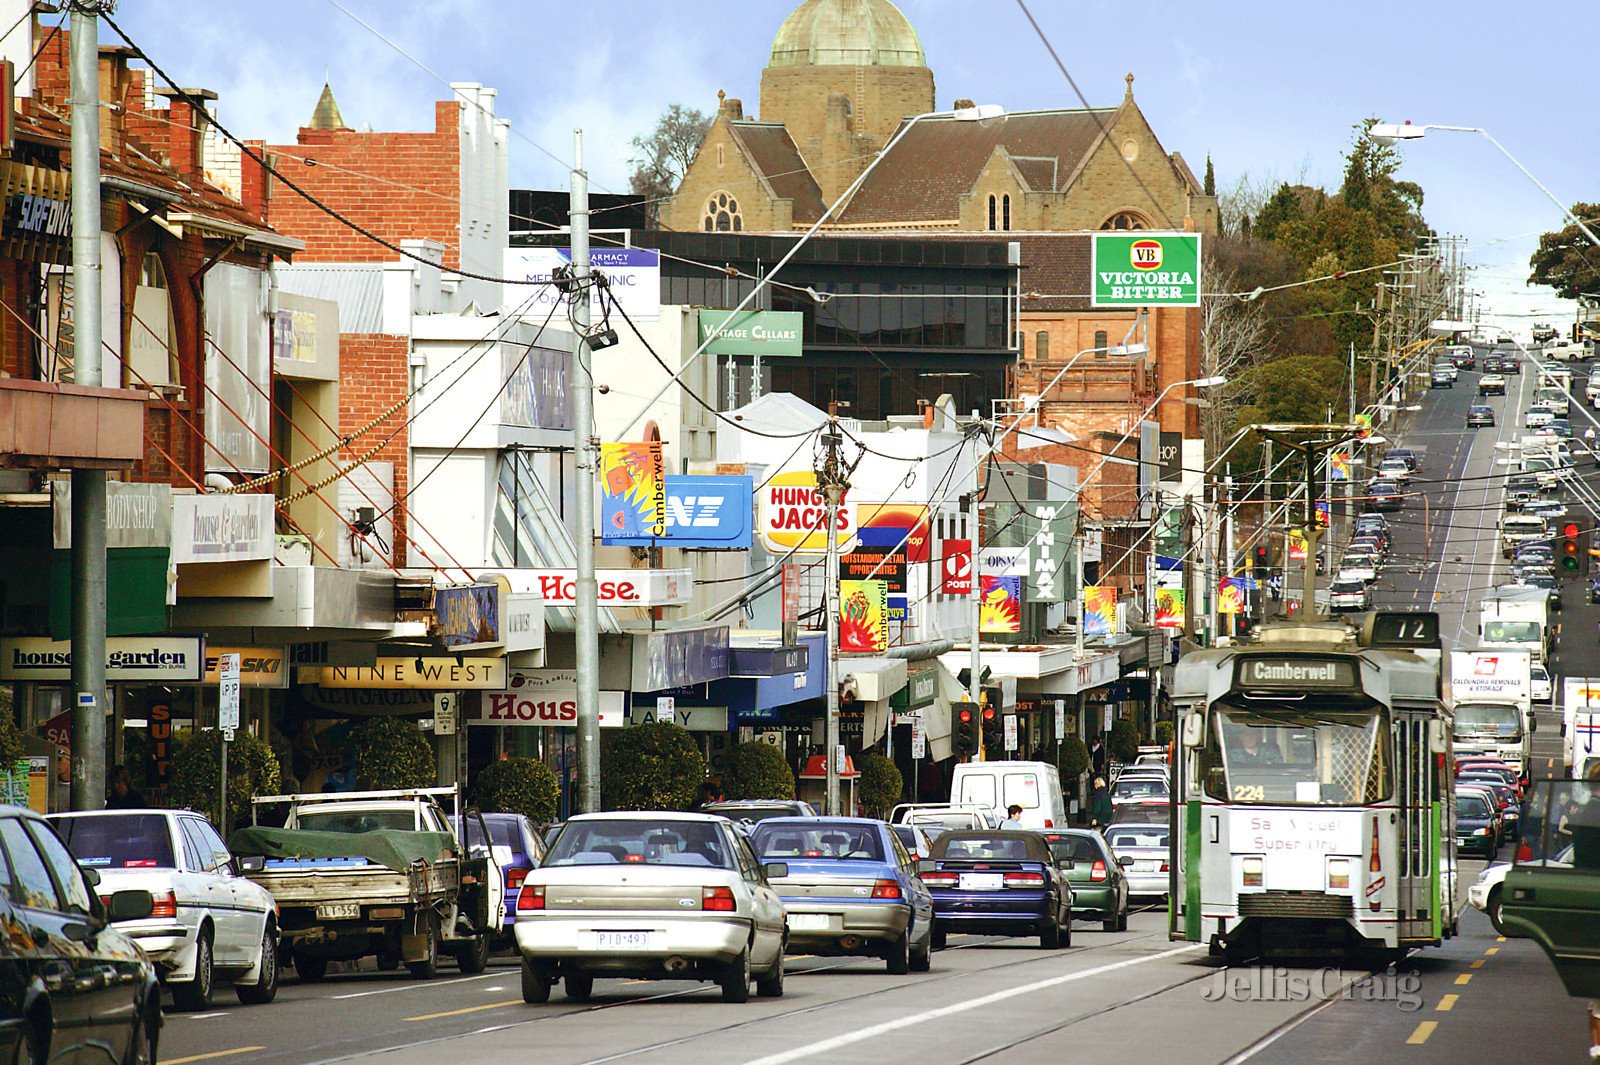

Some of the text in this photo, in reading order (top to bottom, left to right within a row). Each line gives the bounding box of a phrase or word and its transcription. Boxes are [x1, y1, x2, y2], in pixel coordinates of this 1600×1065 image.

[18, 194, 50, 233] SURF
[1136, 249, 1156, 261] VB
[1099, 272, 1195, 285] VICTORIA
[1111, 286, 1183, 299] BITTER
[752, 325, 796, 339] CELLARS
[771, 488, 849, 506] HUNGY
[107, 494, 157, 529] BODY SHOP
[194, 504, 219, 542] house
[231, 504, 259, 544] garden
[1034, 506, 1056, 599] MINIMAX
[988, 556, 1015, 567] OPSM
[538, 576, 640, 600] Hose.
[947, 580, 971, 589] POST
[1398, 619, 1425, 638] 72
[110, 649, 186, 669] garden
[240, 658, 281, 673] SKI
[333, 665, 493, 682] NINE WEST
[1254, 662, 1336, 680] Camberwell
[1234, 785, 1265, 800] 224
[1254, 837, 1301, 851] Super
